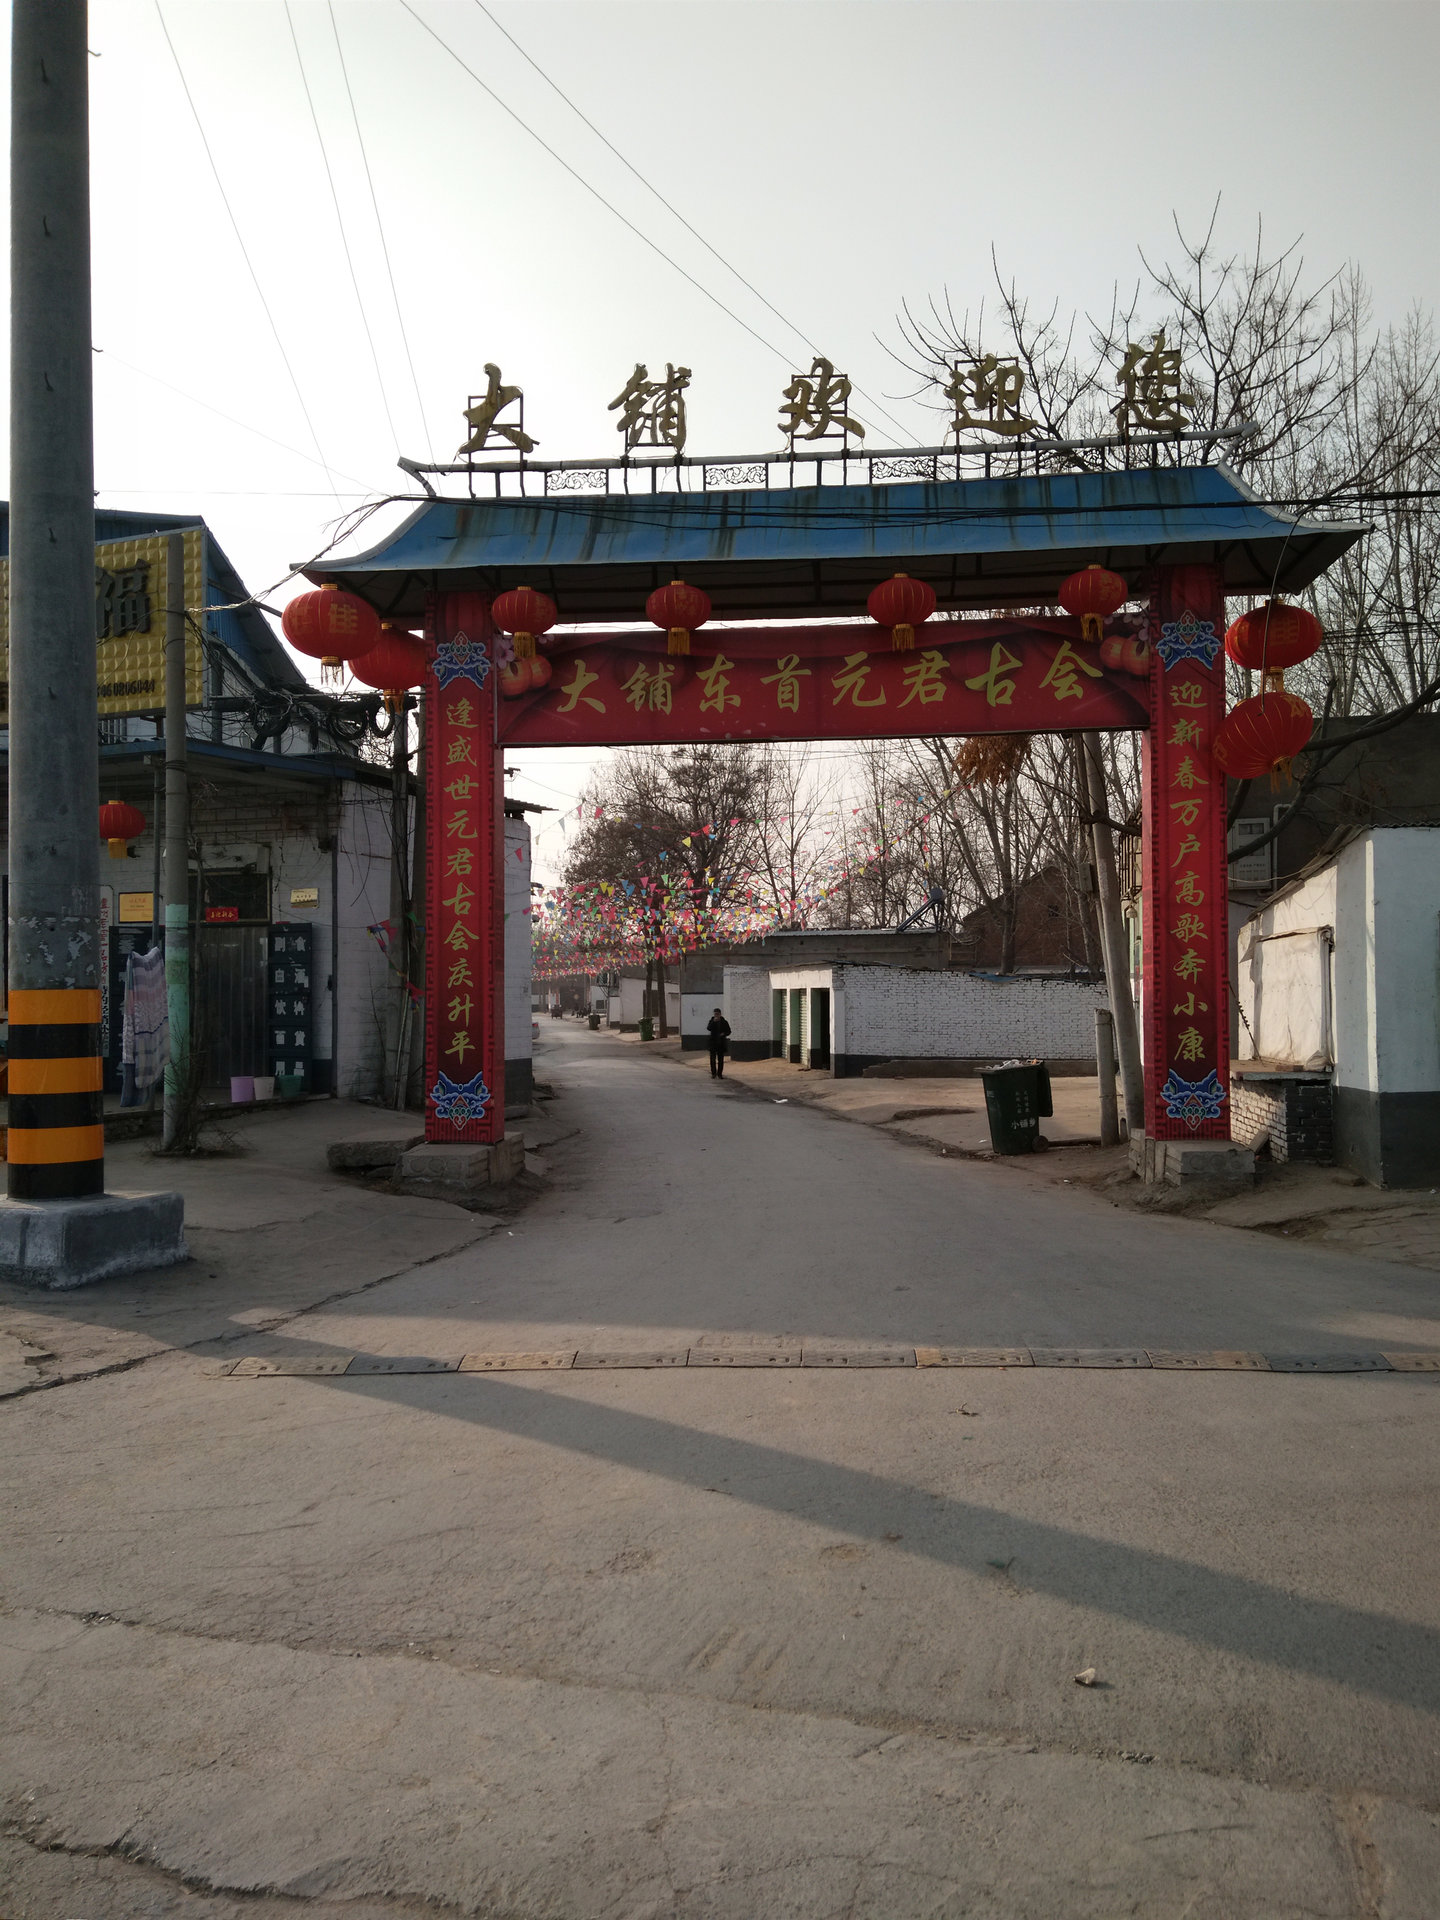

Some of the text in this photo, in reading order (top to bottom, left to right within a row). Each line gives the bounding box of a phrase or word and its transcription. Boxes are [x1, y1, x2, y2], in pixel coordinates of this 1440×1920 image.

[556, 641, 1105, 715] 大铺东首元君古会
[443, 697, 478, 1065] 逢盛世元君古会庆升平
[1167, 681, 1209, 1064] 迎新春万户高歌奔小康
